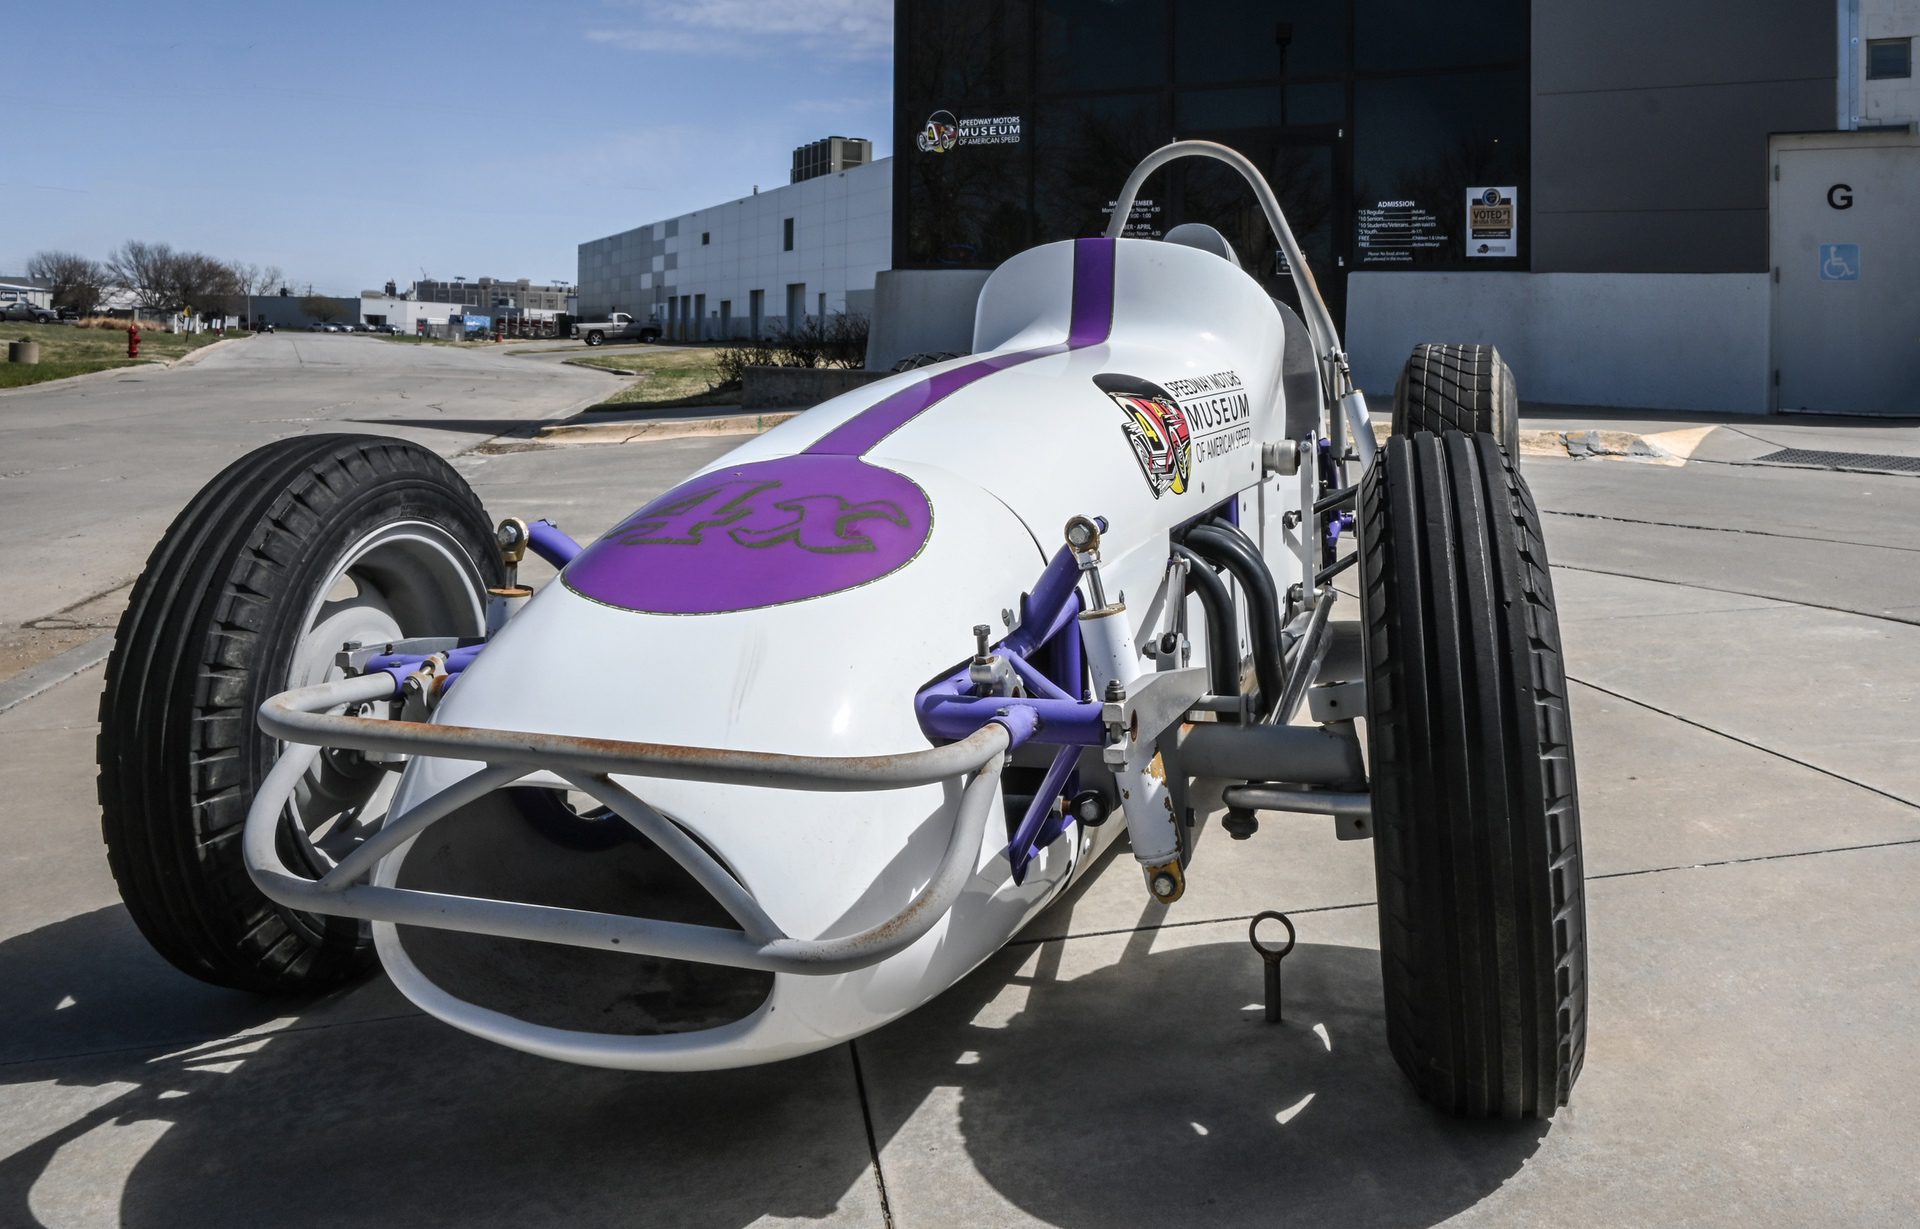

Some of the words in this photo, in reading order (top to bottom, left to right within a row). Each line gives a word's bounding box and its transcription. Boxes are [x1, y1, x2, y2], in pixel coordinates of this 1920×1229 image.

[960, 118, 992, 126] SPEEDWAY
[993, 116, 1020, 124] MOTORS
[958, 126, 1020, 136] MUSEUM
[968, 137, 1000, 145] AMERICAN
[1827, 184, 1853, 210] G
[1473, 210, 1502, 219] VOTED
[1164, 374, 1213, 398] SPEEDWAY
[1210, 370, 1242, 389] MOTORS
[1184, 394, 1250, 432] MUSEUM
[1196, 442, 1206, 464] OF
[1206, 434, 1236, 460] AMERICAN
[1236, 427, 1250, 449] SPEED
